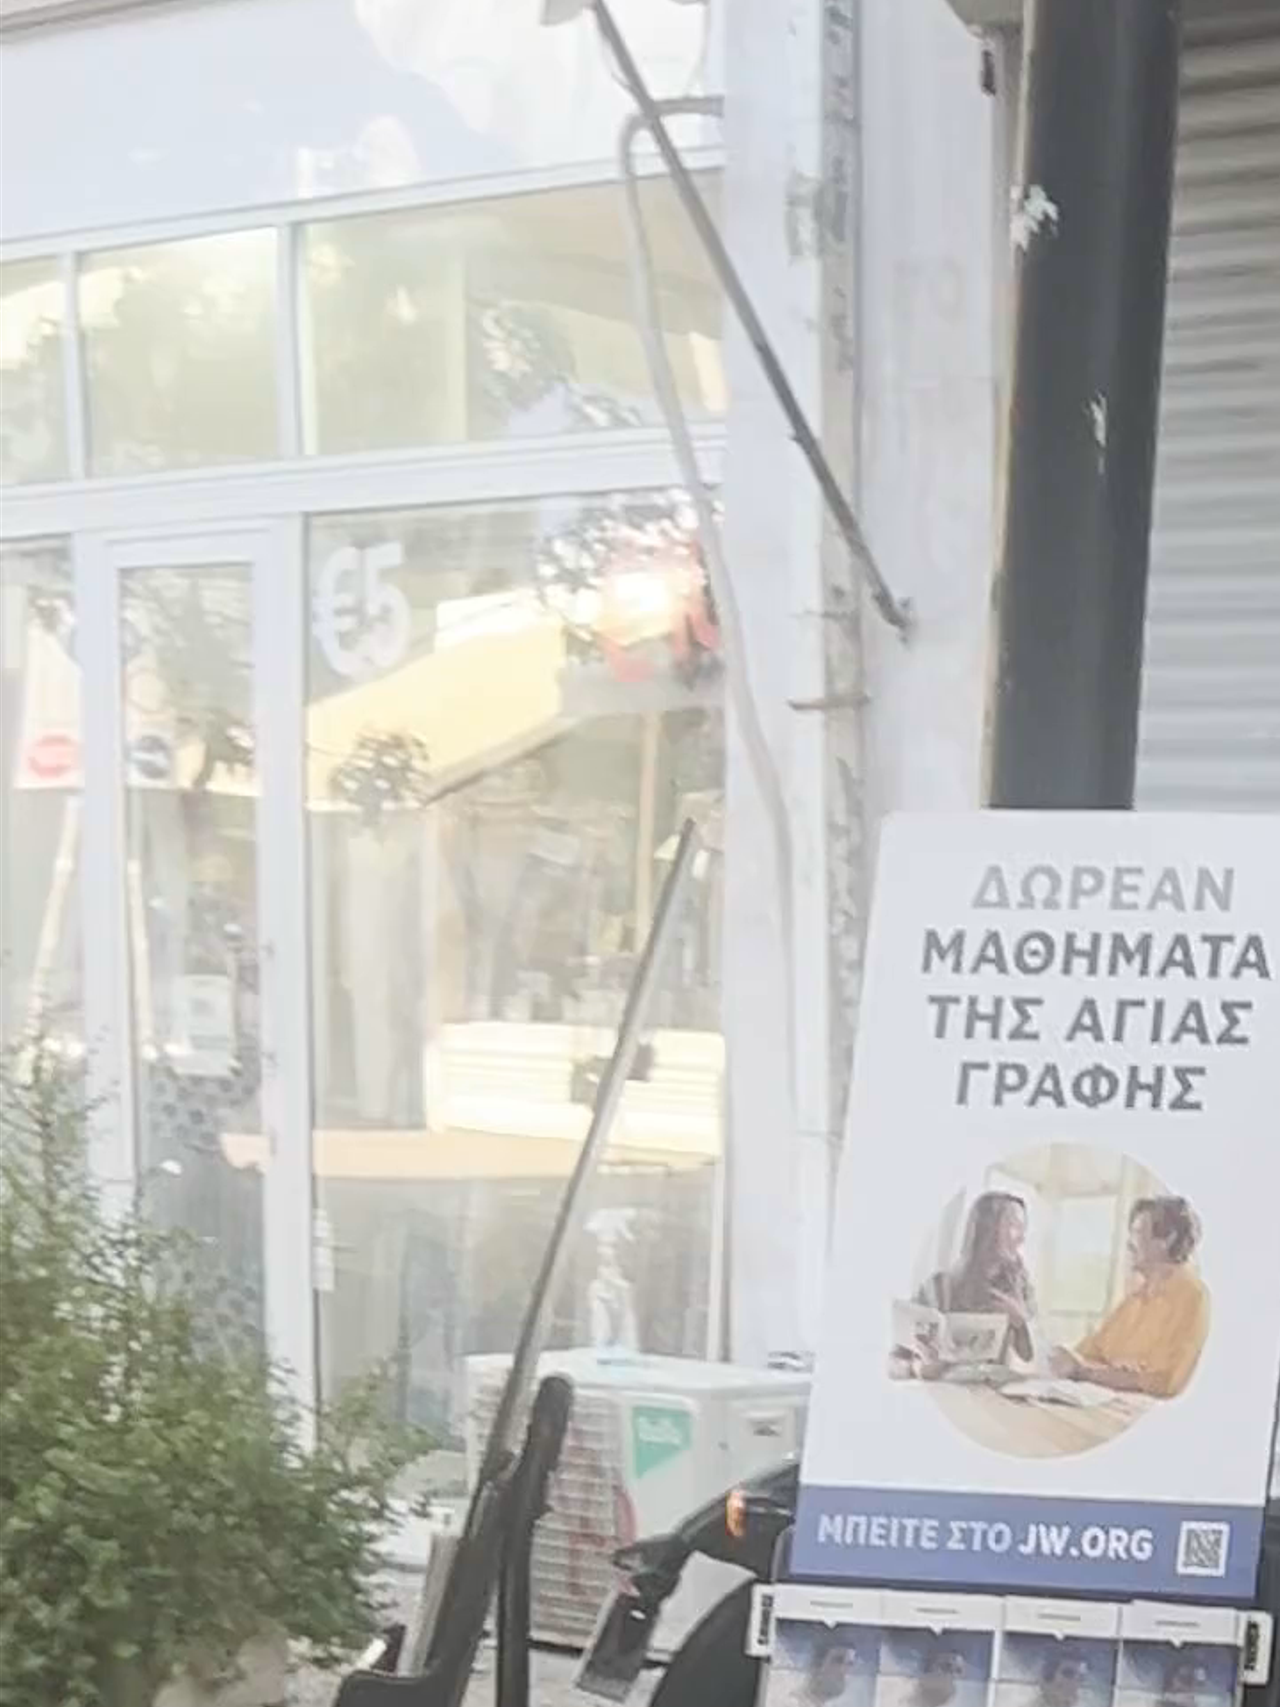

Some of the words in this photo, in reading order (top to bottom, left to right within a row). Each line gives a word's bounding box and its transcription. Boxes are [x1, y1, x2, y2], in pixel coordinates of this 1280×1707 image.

[971, 863, 1235, 912] ΔΩΡΕΑΝ
[921, 927, 1272, 980] ΜΑΘΗΜΑΤΑ
[927, 994, 1045, 1041] ΤΗΣ
[1065, 996, 1253, 1045] ΑΓΙΑΣ
[955, 1061, 1207, 1111] ΓΡΑΦΗΣ
[816, 1513, 939, 1551] ΜΠΕΙΤΕ
[946, 1520, 1013, 1555] ΣΤΟ
[1018, 1523, 1155, 1562] JW.ORG
